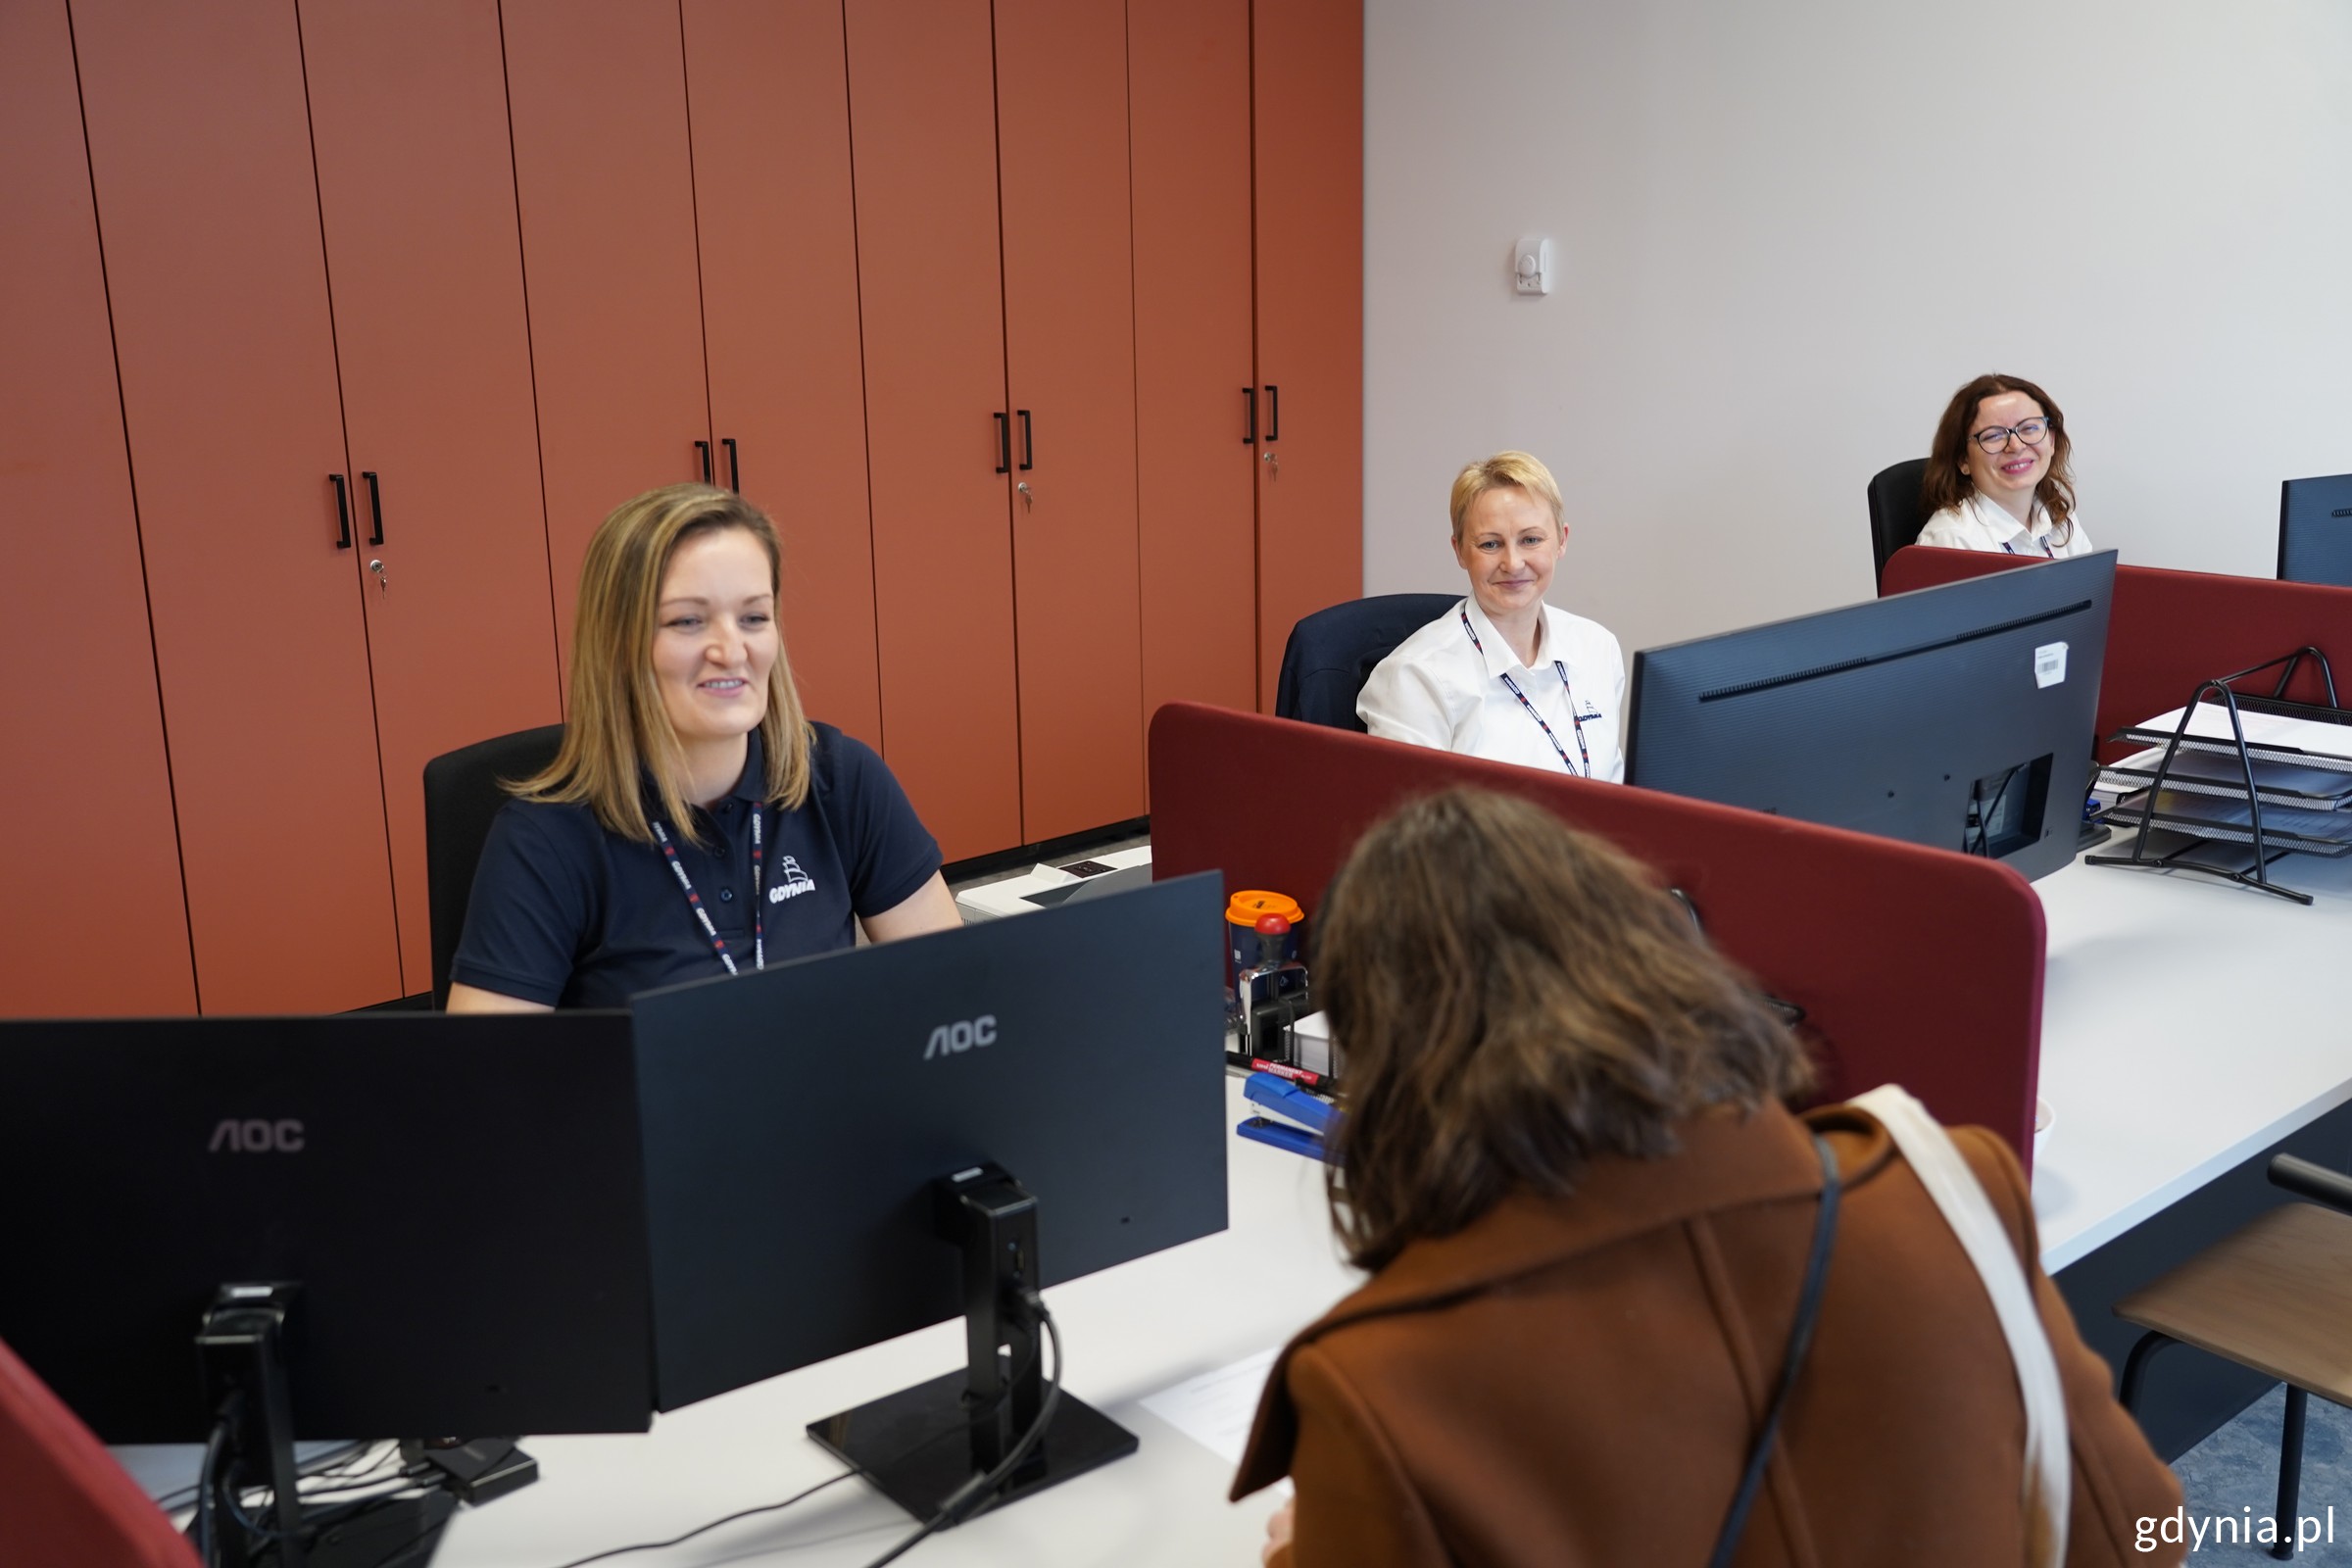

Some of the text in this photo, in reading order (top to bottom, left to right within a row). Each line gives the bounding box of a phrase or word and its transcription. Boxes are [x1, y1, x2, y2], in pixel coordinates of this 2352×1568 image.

[753, 813, 761, 844] GDYNIA
[671, 860, 692, 890] GDYNIA
[769, 879, 815, 905] GDYNIA
[696, 907, 716, 936] GDYNIA
[923, 1014, 998, 1060] AOC
[1268, 1067, 1294, 1079] MARKER
[1269, 1063, 1303, 1075] PERMANENT
[208, 1119, 305, 1152] AOC
